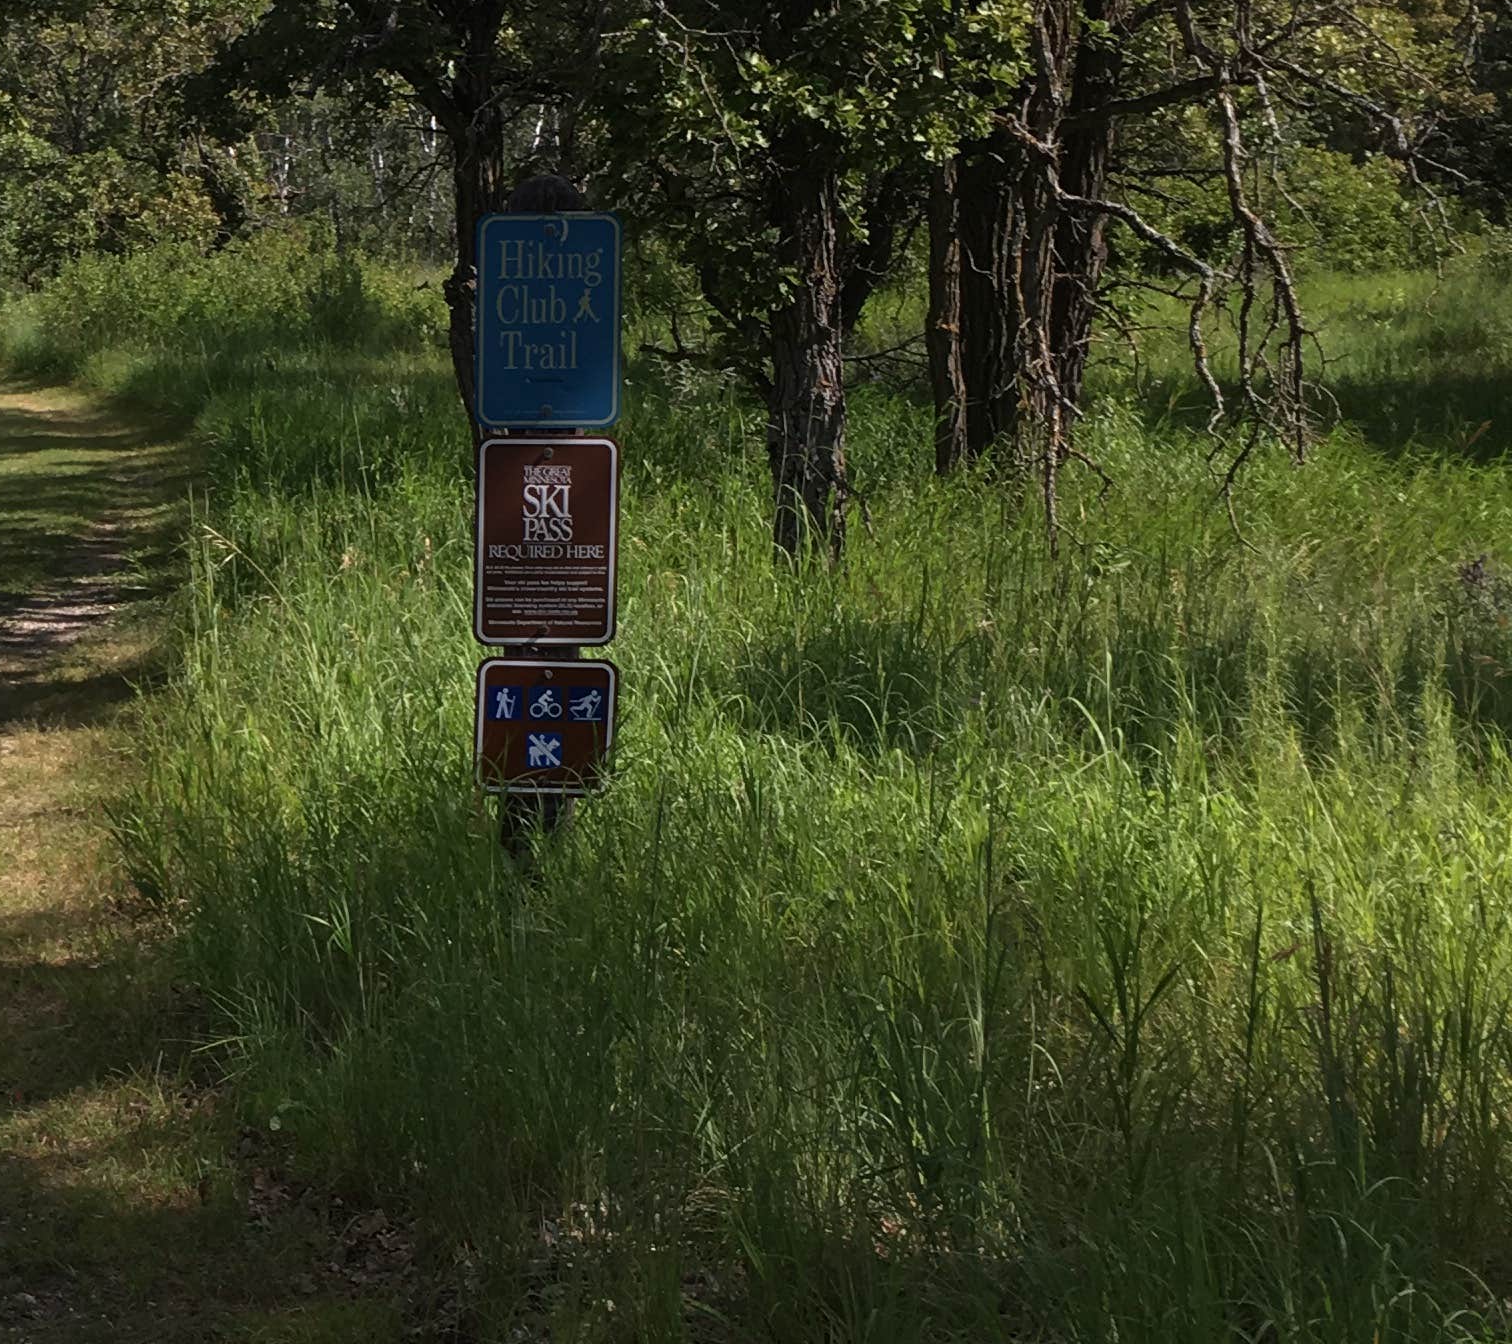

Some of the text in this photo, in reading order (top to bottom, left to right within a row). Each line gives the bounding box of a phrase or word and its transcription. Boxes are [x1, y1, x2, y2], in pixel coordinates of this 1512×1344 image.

[497, 240, 604, 287] Hiking
[496, 285, 566, 324] Club
[499, 331, 578, 370] Trail
[523, 465, 541, 476] THE
[523, 484, 572, 518] SKI
[522, 518, 573, 542] PASS
[488, 544, 605, 562] REQUIRED HERE
